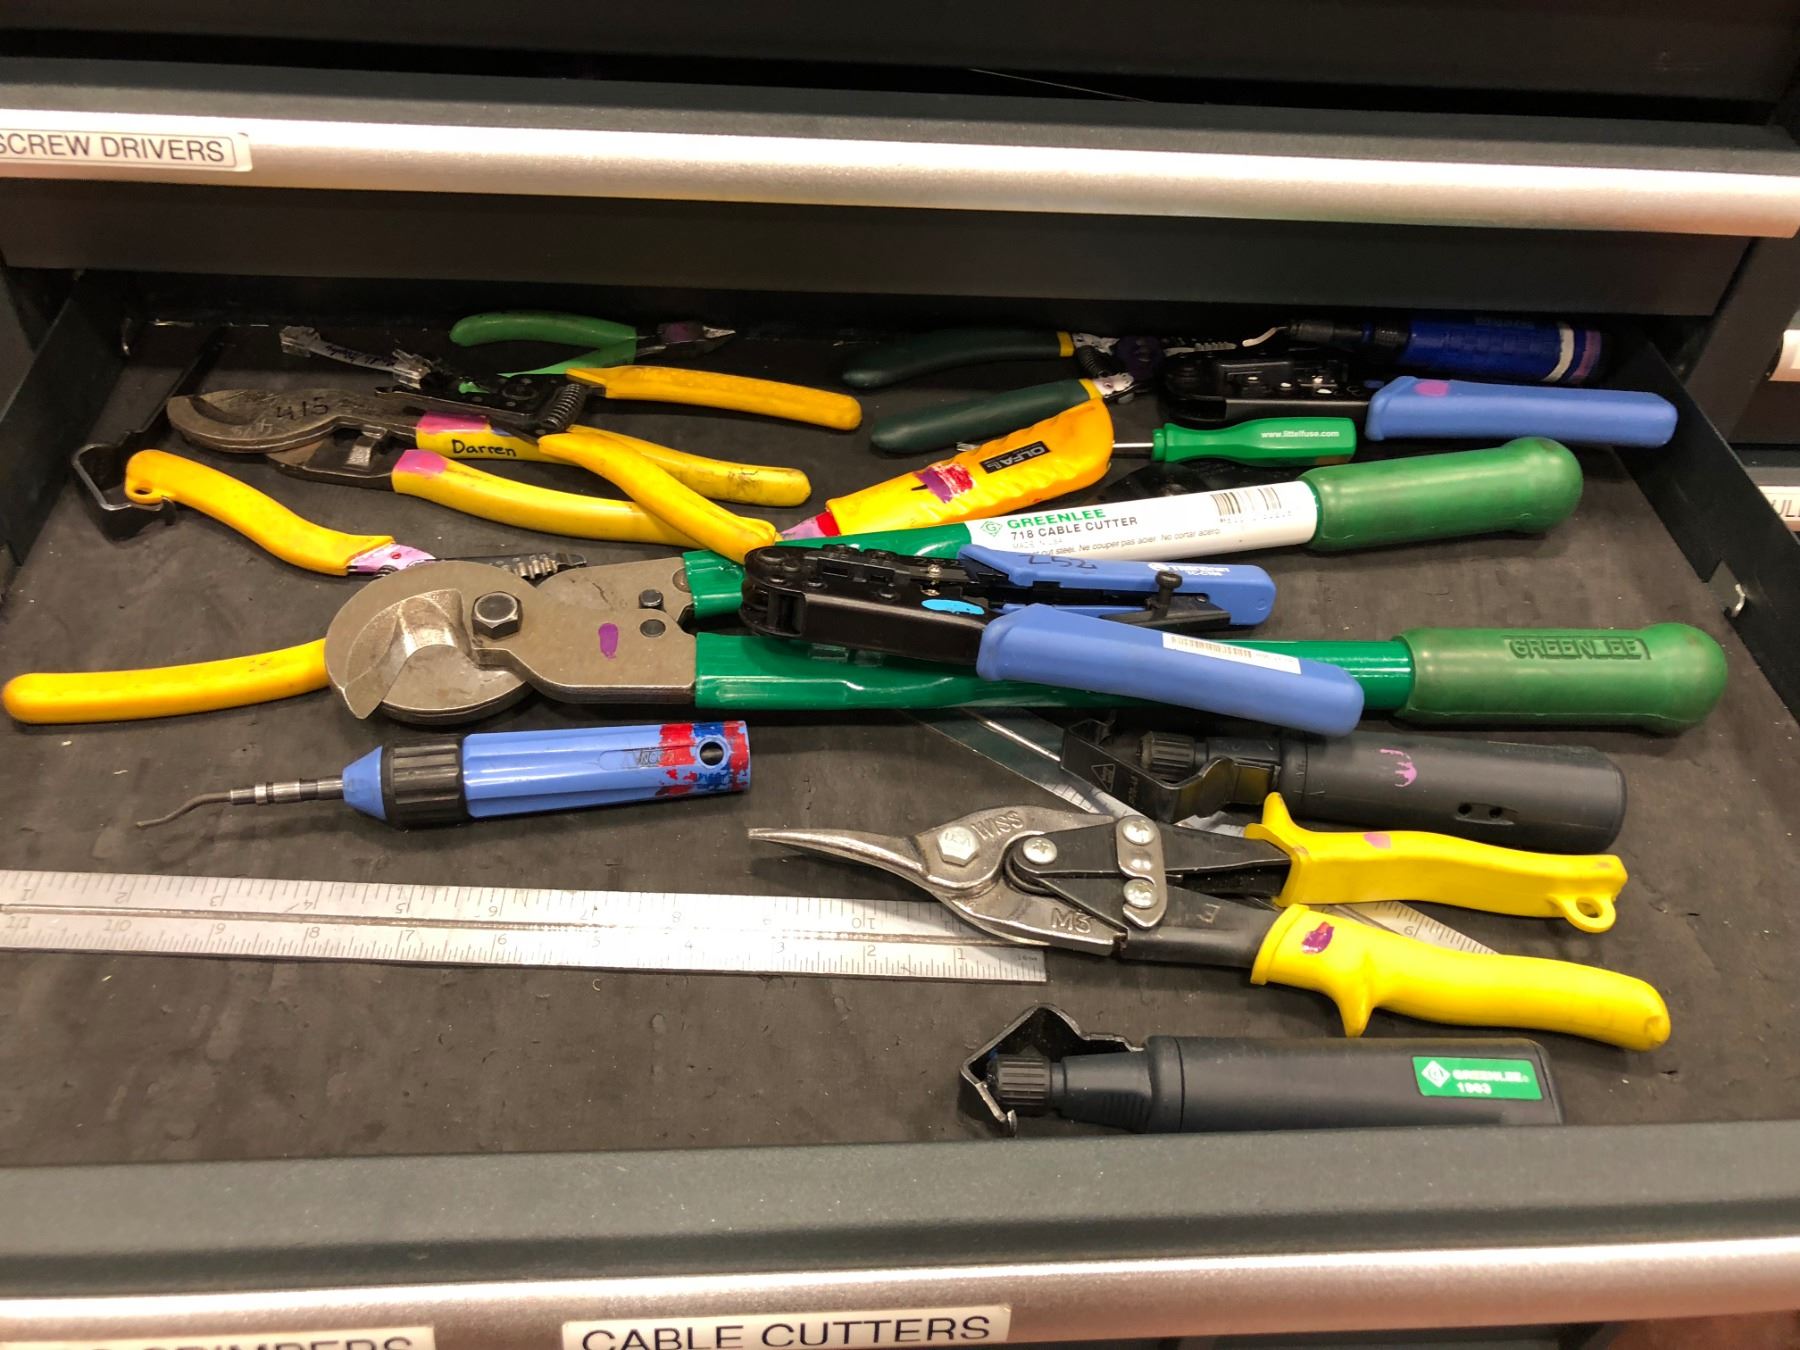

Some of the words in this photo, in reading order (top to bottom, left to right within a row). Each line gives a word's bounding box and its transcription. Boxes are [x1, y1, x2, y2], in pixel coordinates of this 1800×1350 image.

[100, 135, 225, 164] DRIVERS
[1260, 429, 1340, 439] www.littelfuse.com
[451, 438, 517, 458] Darren
[1007, 508, 1106, 530] GREENLEE
[1010, 530, 1034, 541] 718
[1038, 523, 1081, 537] CABLE
[1085, 516, 1138, 531] CUTTER
[1509, 637, 1643, 661] GREENLEE
[970, 810, 1024, 841] WISS
[1051, 907, 1093, 934] M3
[103, 919, 132, 932] 10
[214, 922, 226, 935] 9
[308, 926, 321, 939] 8
[404, 929, 415, 941] 7
[497, 934, 508, 945] 6
[866, 944, 877, 957] 2
[581, 1325, 745, 1350] CABLE
[761, 1316, 991, 1347] CUTTERS
